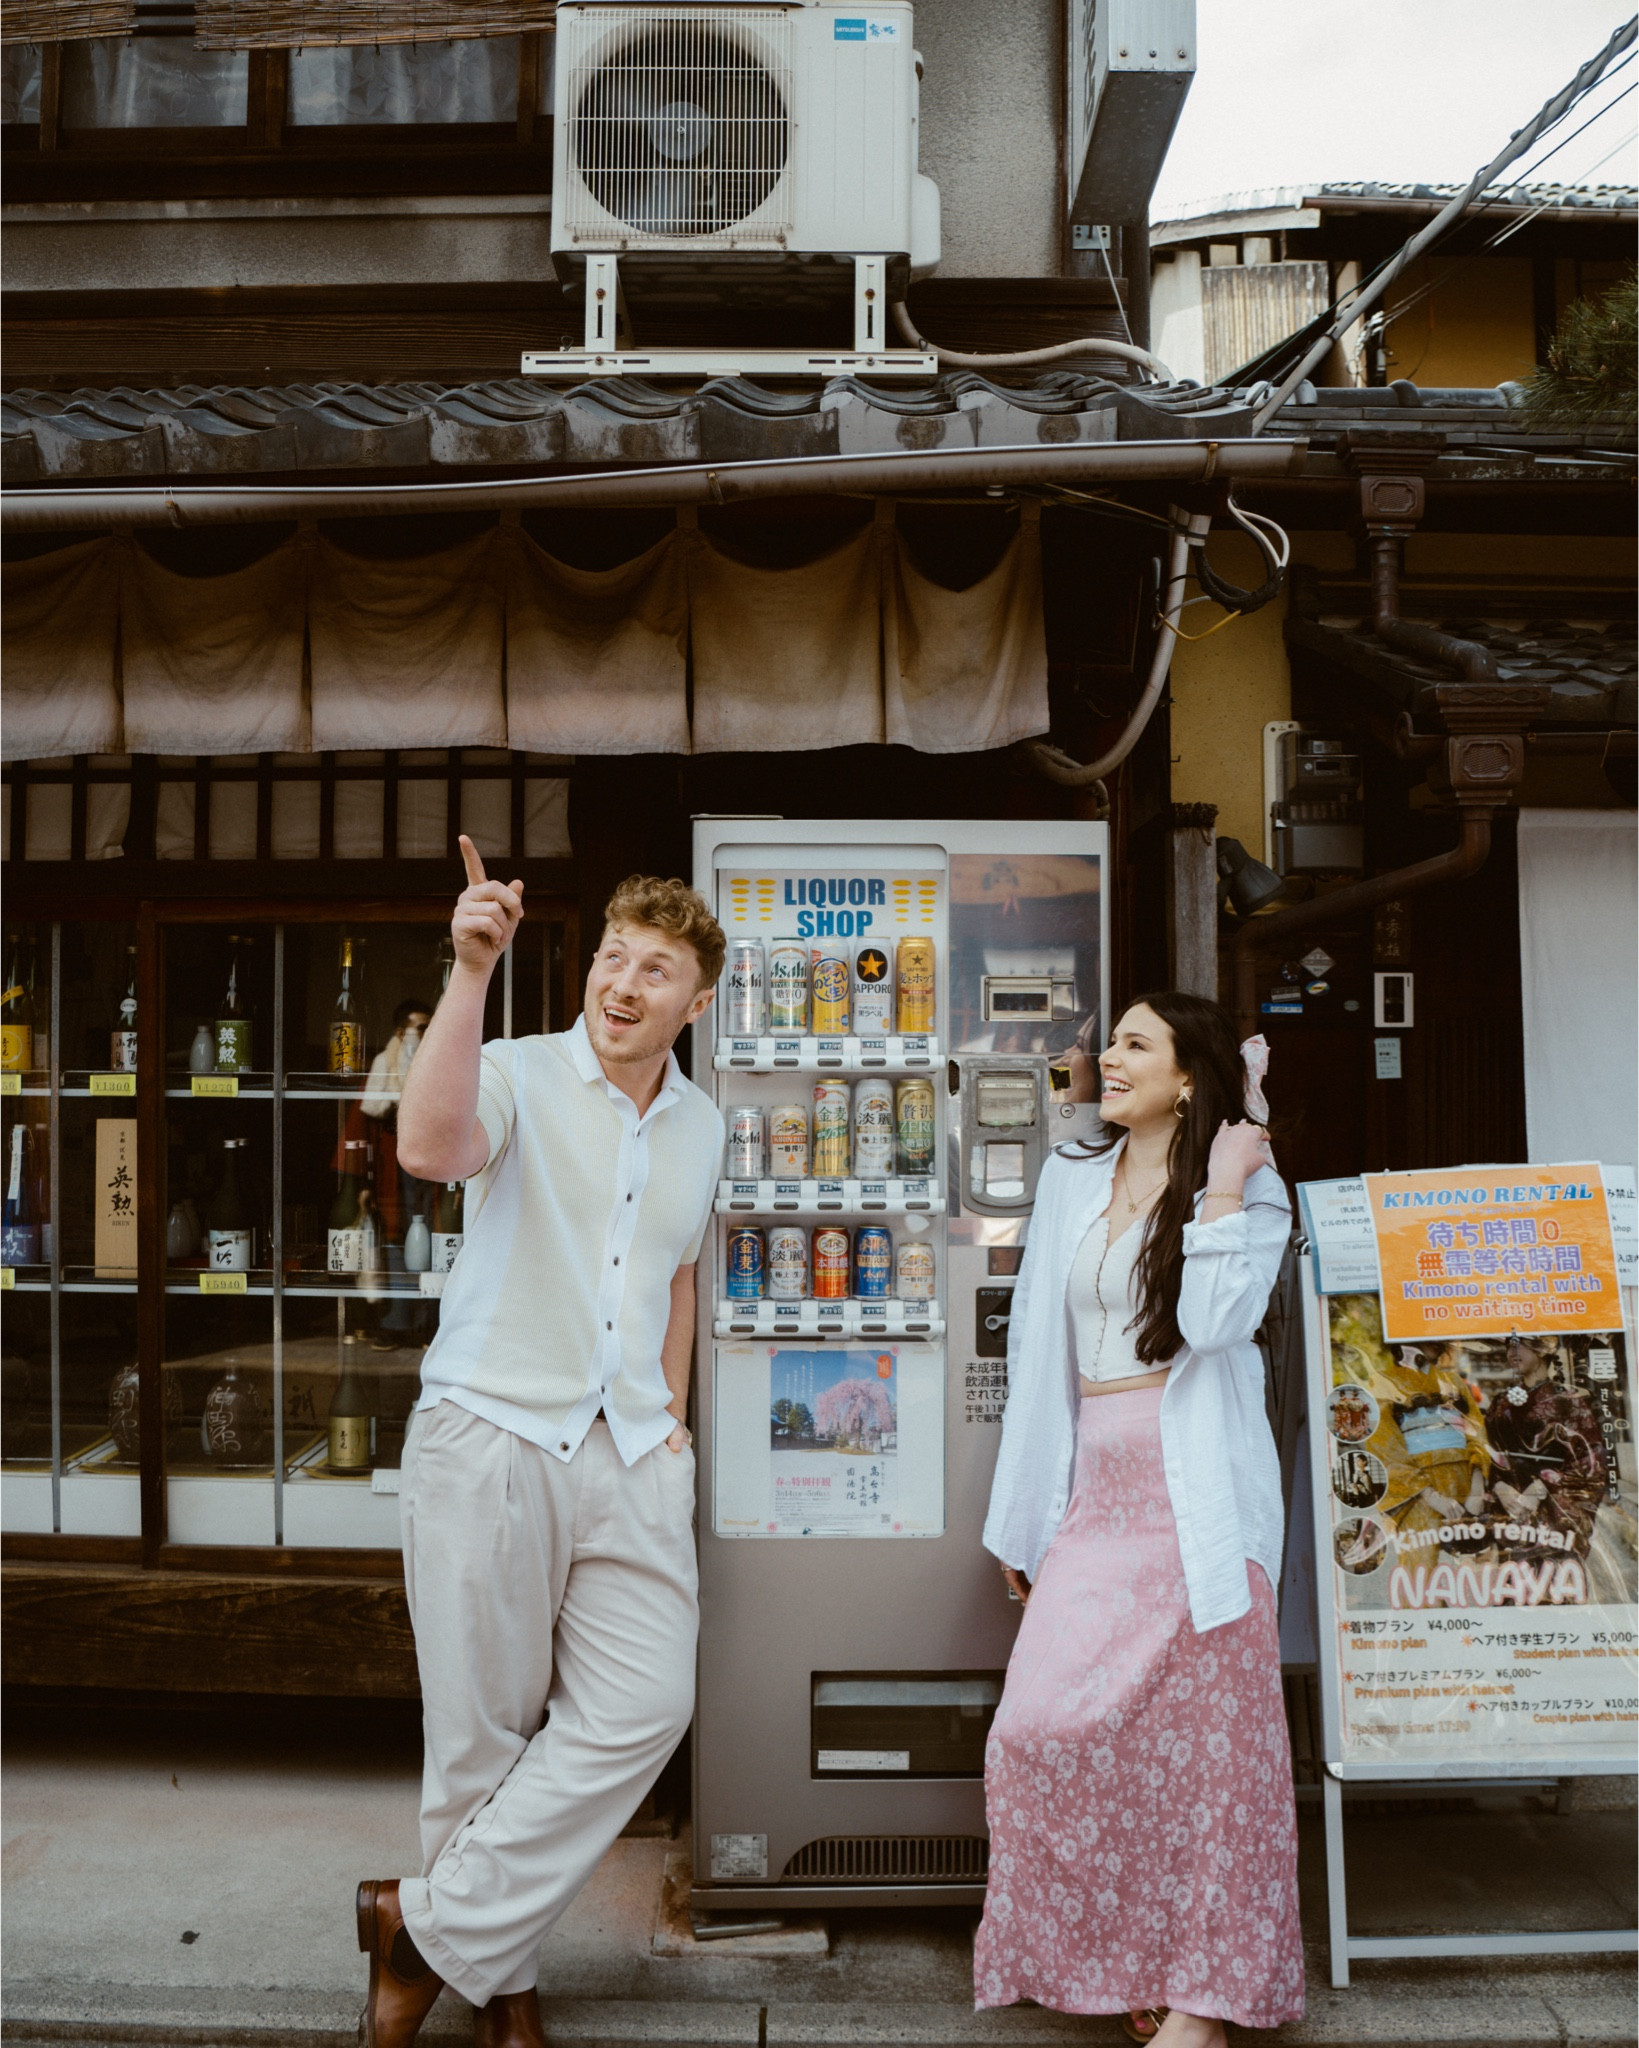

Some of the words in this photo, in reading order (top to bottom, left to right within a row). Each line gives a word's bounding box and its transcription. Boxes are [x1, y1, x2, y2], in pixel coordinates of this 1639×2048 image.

[784, 878, 886, 909] LIQUOR
[797, 910, 874, 938] SHOP
[771, 960, 807, 979] Asahi
[728, 972, 762, 988] Asahi
[852, 983, 892, 994] SAPPORO
[819, 1106, 847, 1122] 金麦
[728, 1131, 760, 1145] Asahi
[1382, 1187, 1488, 1209] KIMONO
[1493, 1183, 1594, 1203] RENTAL
[1416, 1244, 1582, 1279] 無需等待時間
[1402, 1280, 1480, 1299] Kimono
[1484, 1275, 1548, 1296] rental
[1553, 1273, 1602, 1293] with
[1423, 1303, 1449, 1321] no
[1454, 1299, 1535, 1320] waiting
[1538, 1297, 1586, 1316] time
[1390, 1522, 1487, 1554] Kimono
[1492, 1521, 1577, 1551] rental
[1388, 1558, 1588, 1610] NANAYA
[1349, 1620, 1415, 1634] 着物プラン
[1351, 1638, 1399, 1650] Kimono
[1401, 1637, 1428, 1652] plan
[1471, 1632, 1580, 1647] ヘア付き学生プラン
[1513, 1648, 1556, 1660] Student
[1557, 1648, 1581, 1661] plan
[1582, 1647, 1607, 1658] with
[1353, 1668, 1486, 1683] ヘア付きプレミアムプラン
[1354, 1687, 1411, 1700] Premium
[1413, 1685, 1440, 1700] plan
[1442, 1684, 1470, 1697] with
[1478, 1699, 1595, 1712] ヘア付きカップルプラン
[1532, 1713, 1568, 1725] Couple
[1569, 1712, 1592, 1724] plan
[1593, 1711, 1616, 1722] with
